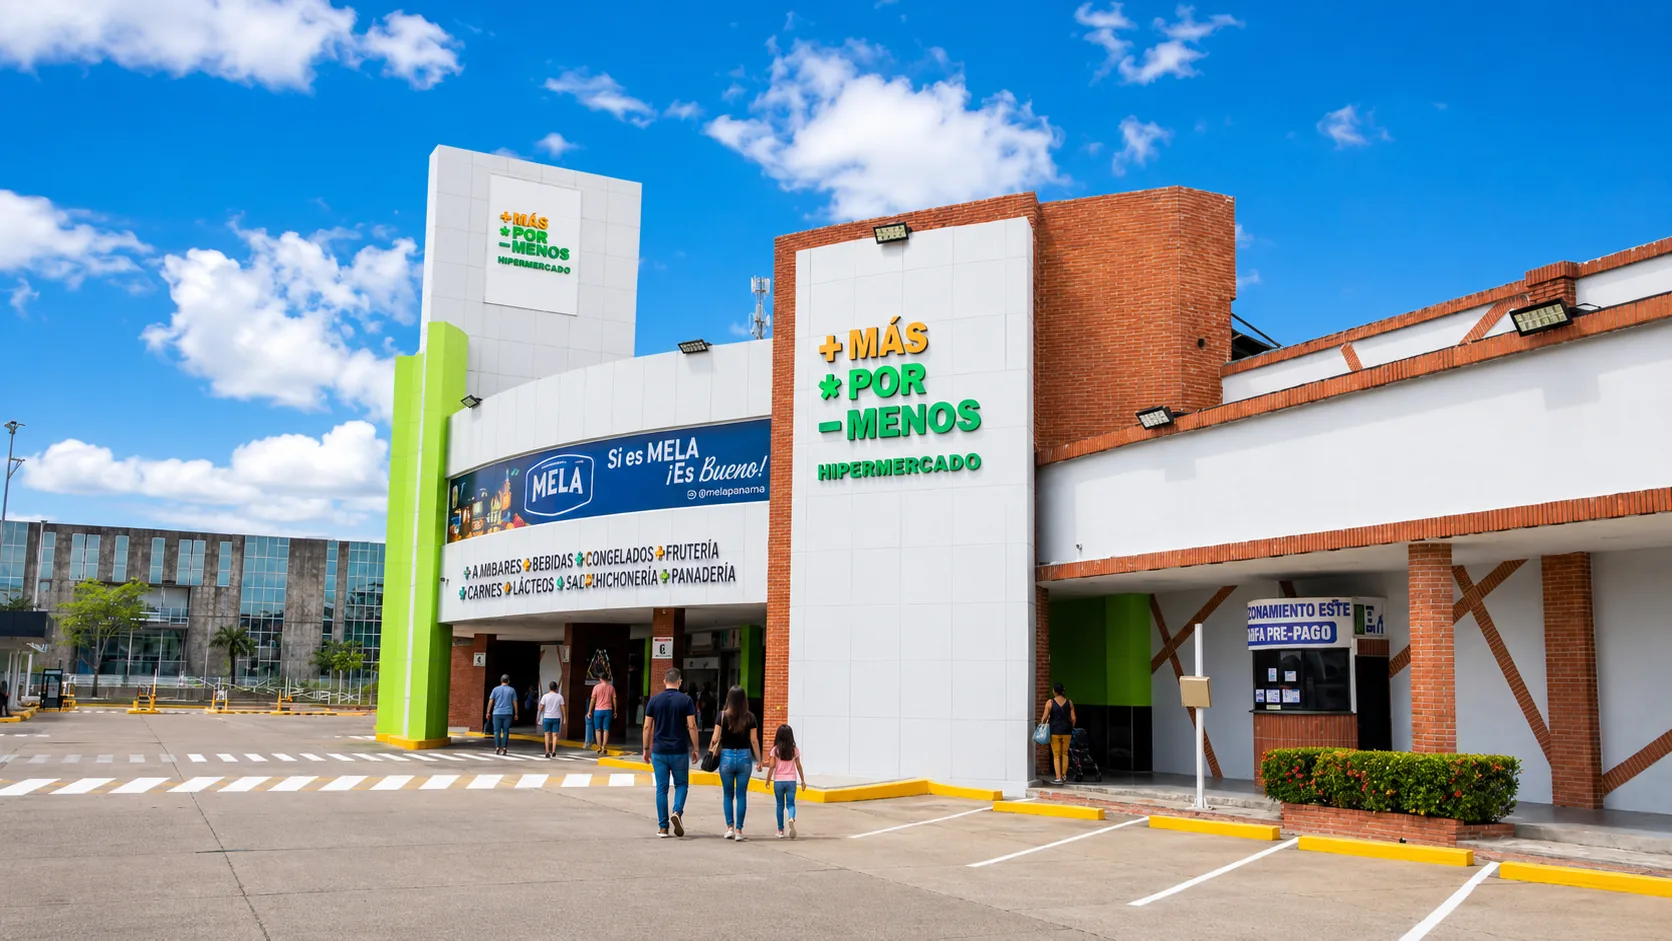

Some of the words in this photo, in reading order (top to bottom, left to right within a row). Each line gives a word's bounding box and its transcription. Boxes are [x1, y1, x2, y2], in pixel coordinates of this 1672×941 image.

[512, 226, 547, 244] POR
[513, 212, 548, 230] MÁS
[512, 240, 570, 260] MENOS
[498, 256, 571, 274] HIPERMERCADO
[849, 316, 928, 360] MÁS
[849, 363, 926, 400] POR
[847, 399, 981, 440] MENOS
[607, 446, 622, 469] Si
[625, 450, 643, 466] es
[647, 436, 699, 463] MELA
[698, 455, 768, 483] Bueno!
[818, 453, 981, 481] HIPERMERCADO
[532, 466, 583, 503] MELA
[698, 485, 765, 499] @melapanama
[532, 553, 574, 572] BEBIDAS
[585, 546, 654, 567] CONGELADOS
[665, 538, 719, 561] FRUTERÍA
[467, 582, 502, 600] CARNES
[513, 576, 554, 595] LÁCTEOS
[671, 562, 736, 584] PANADERÍA
[1319, 602, 1351, 618] ESTE
[1267, 625, 1331, 641] PRE-PAGO
